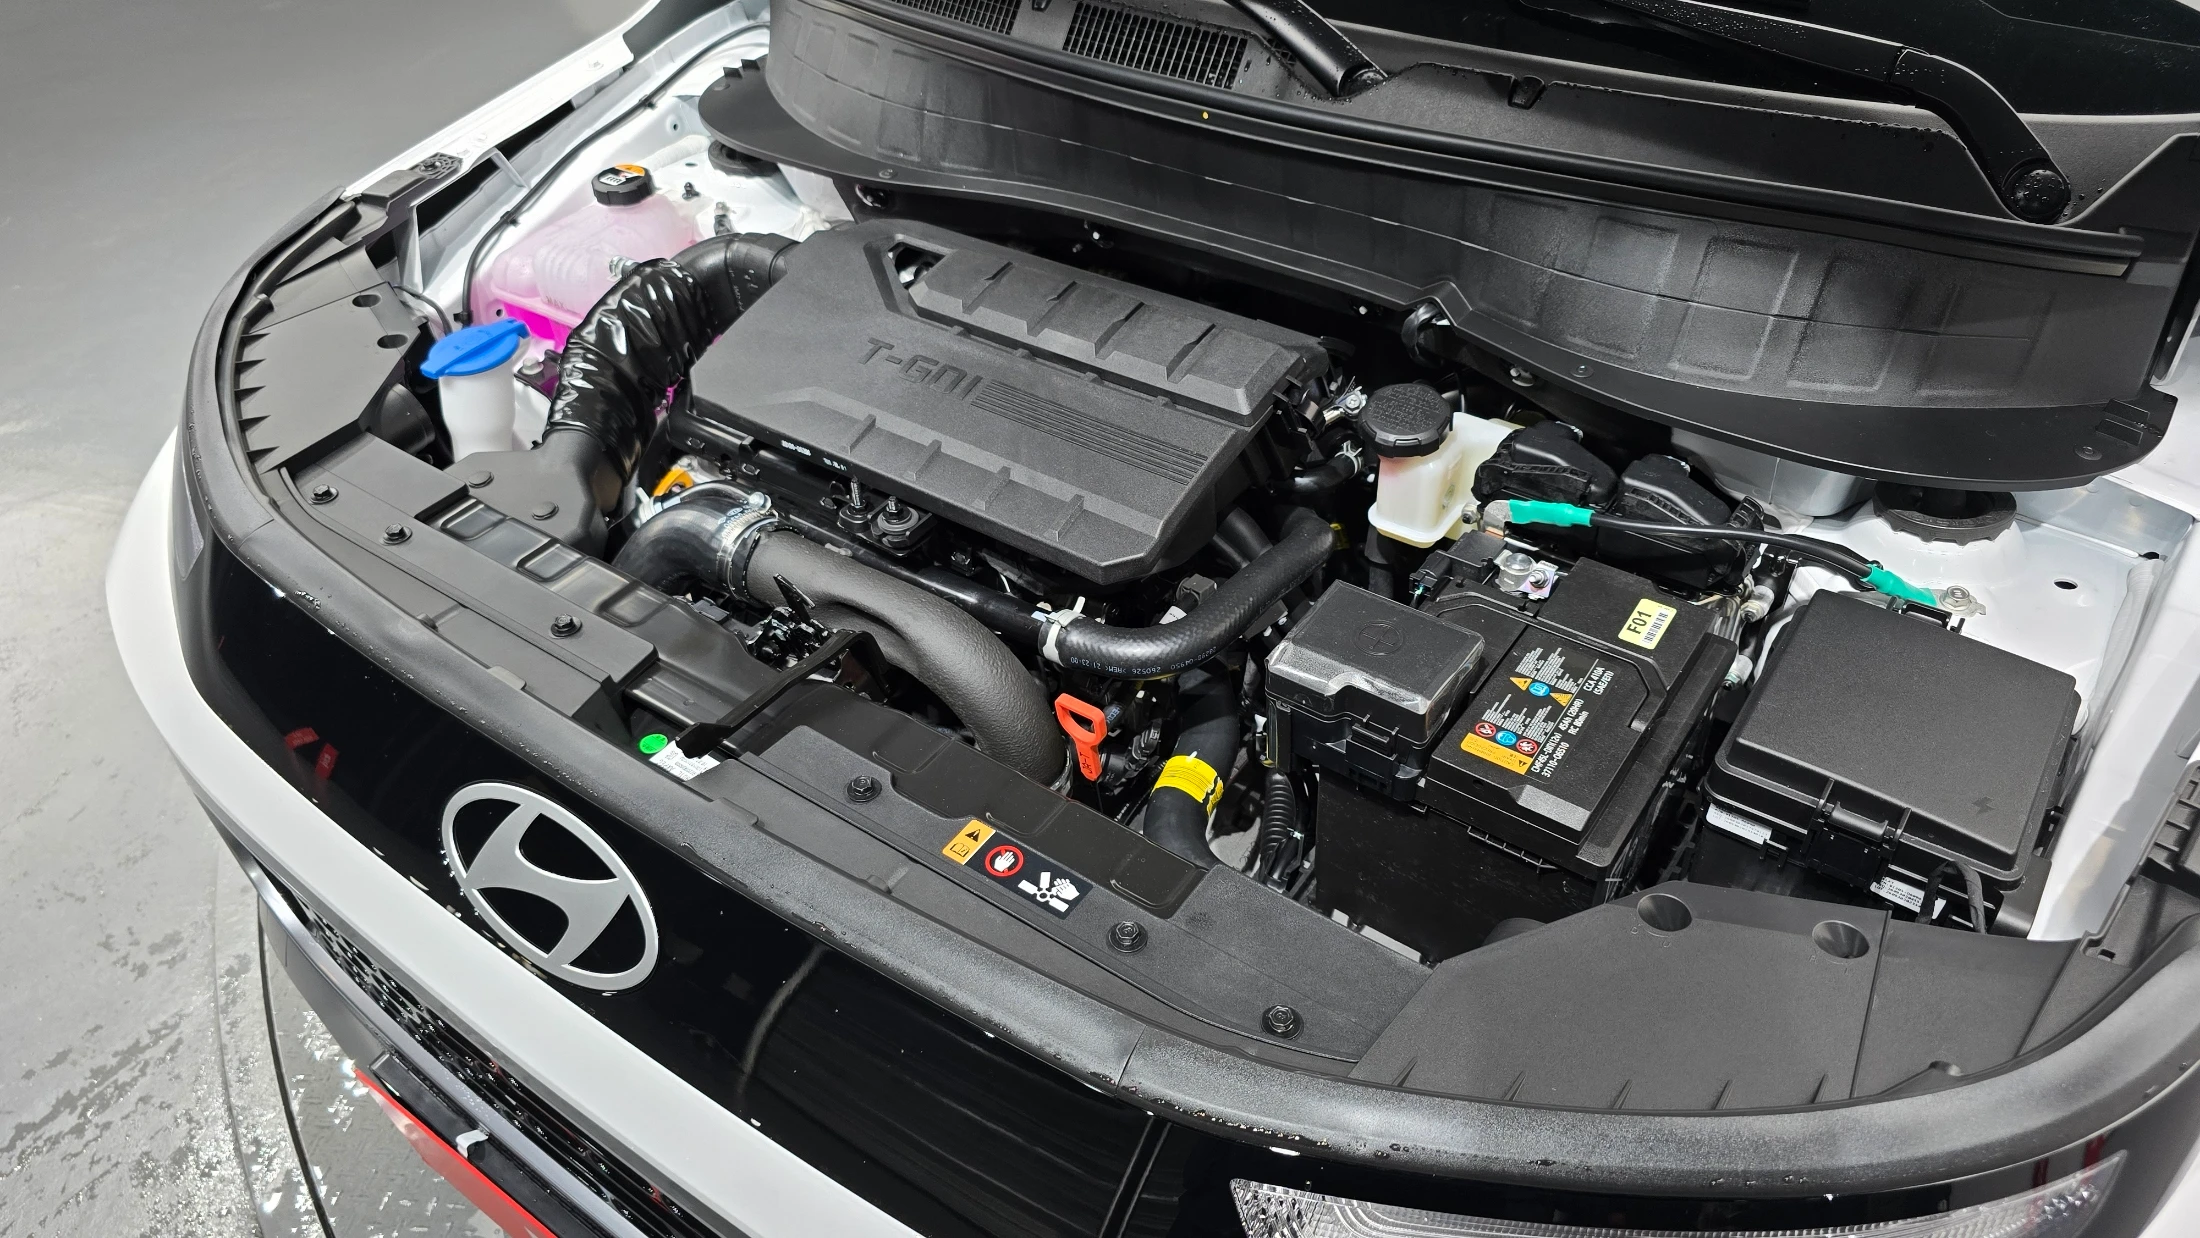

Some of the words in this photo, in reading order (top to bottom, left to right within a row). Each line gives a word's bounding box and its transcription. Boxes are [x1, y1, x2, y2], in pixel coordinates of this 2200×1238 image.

[859, 337, 983, 400] T-GDI
[1626, 610, 1652, 635] F01
[1558, 716, 1573, 731] 45Ah
[1583, 679, 1596, 692] CCA
[1590, 666, 1606, 682] 410A
[1567, 725, 1580, 736] RC
